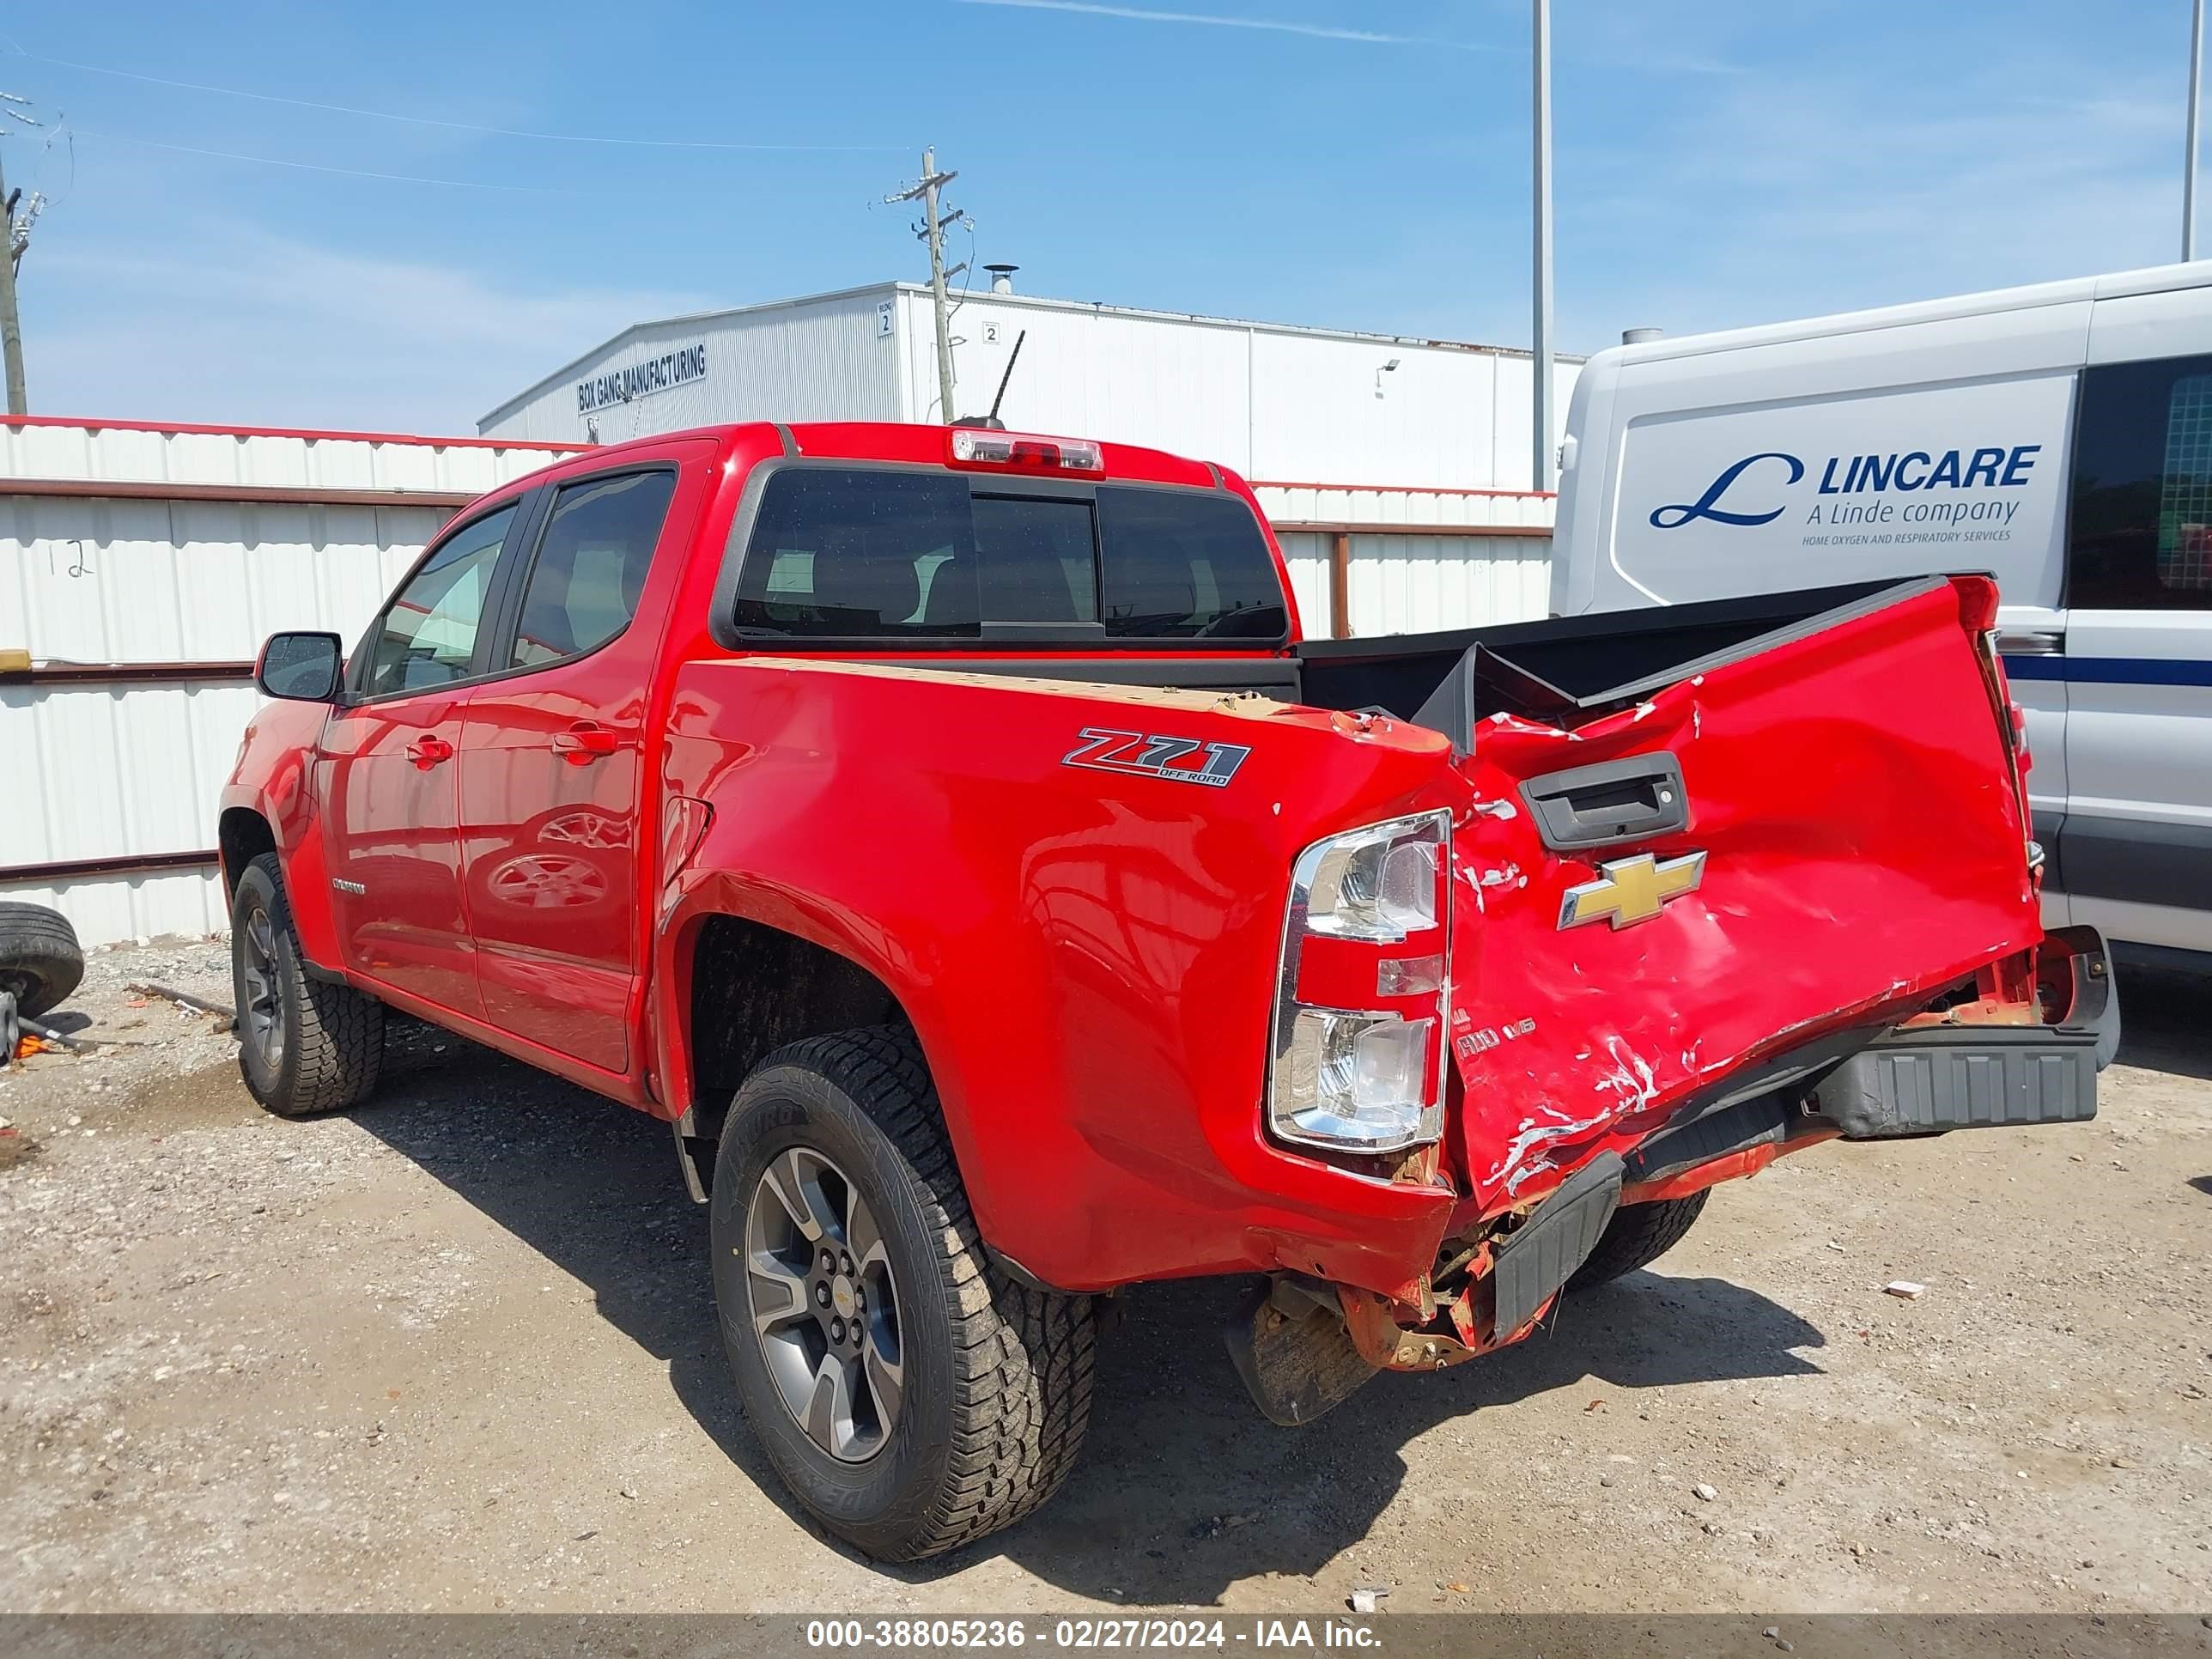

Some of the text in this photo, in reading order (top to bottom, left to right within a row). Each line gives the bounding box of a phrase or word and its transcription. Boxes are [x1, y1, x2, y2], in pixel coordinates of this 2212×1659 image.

[879, 302, 891, 313] BLDG
[883, 314, 890, 331] 2
[987, 327, 996, 341] 2
[579, 343, 706, 411] BOX GANG MANUFACTURING
[1818, 445, 2042, 495] LINCARE
[1806, 499, 2020, 527] A Linde company
[1802, 530, 2012, 546] HOME OXYGEN AND RESPIRATORY SERVICES
[1060, 726, 1254, 780] Z71
[1159, 768, 1228, 786] OFF ROAD
